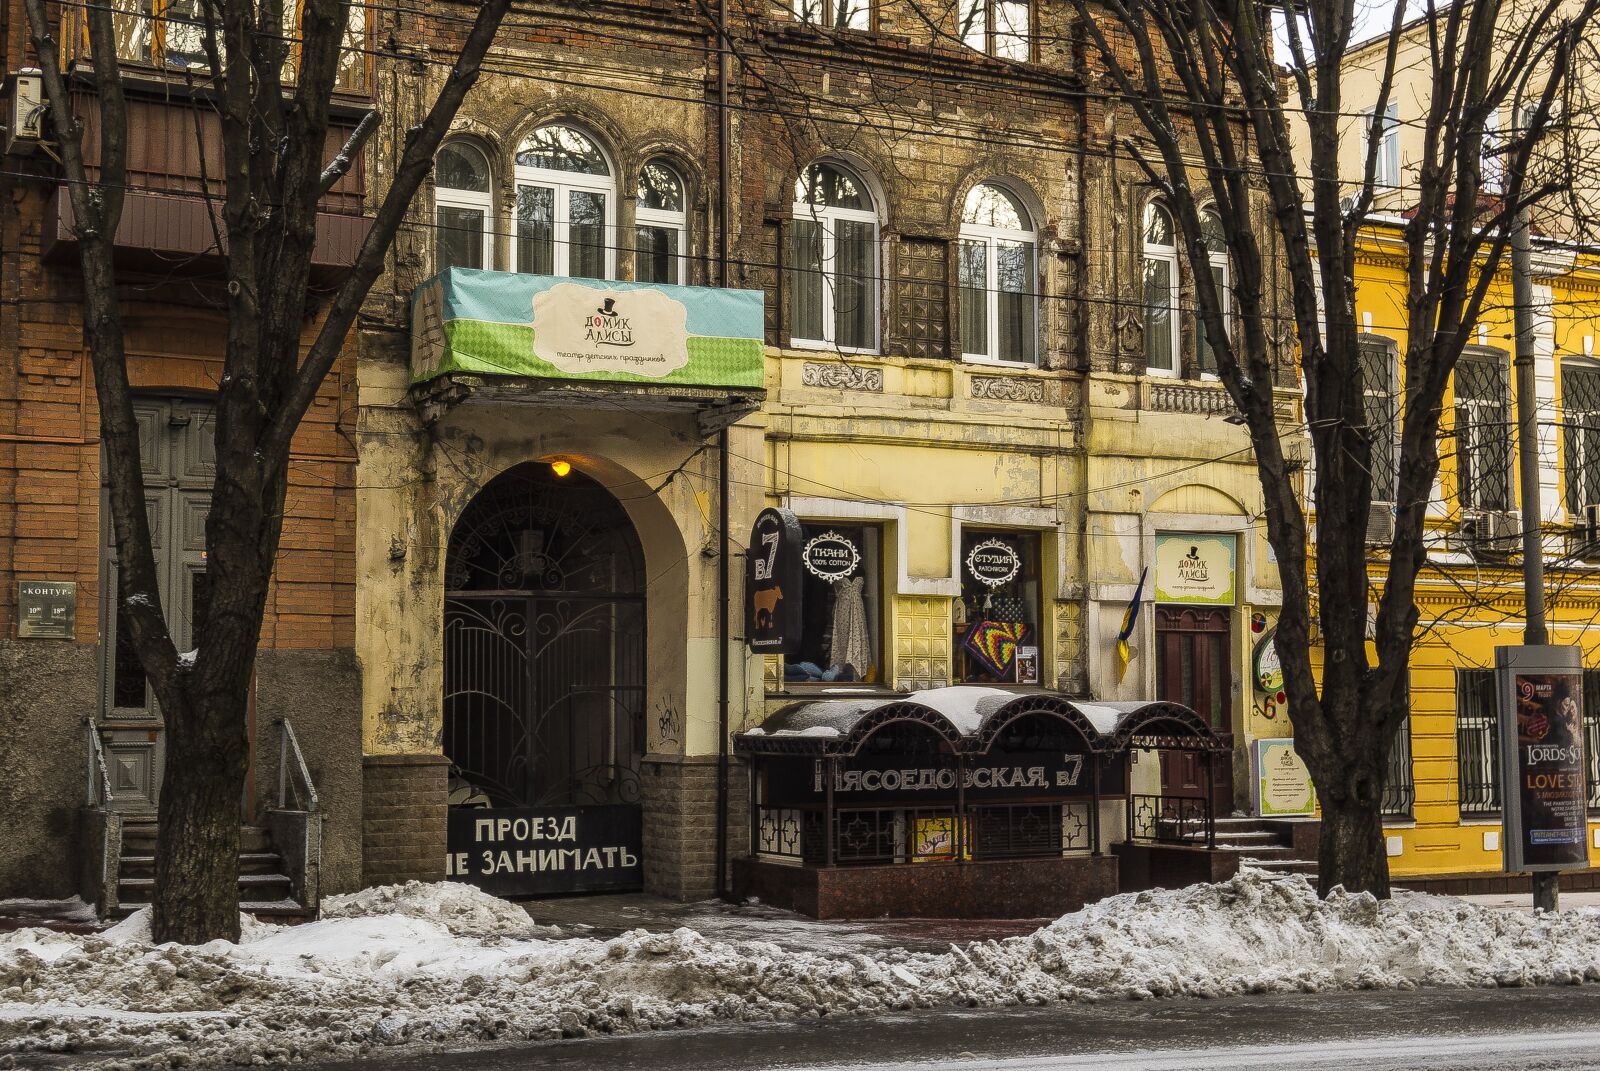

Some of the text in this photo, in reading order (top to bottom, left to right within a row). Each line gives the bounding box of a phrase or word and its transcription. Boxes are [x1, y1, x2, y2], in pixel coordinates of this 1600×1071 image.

[584, 315, 633, 330] ДОМИК
[584, 329, 633, 343] АЛИСЫ
[557, 352, 666, 365] театр детских праздников
[812, 548, 849, 558] ТКАНИ
[974, 554, 1013, 564] СТУДИЯ
[828, 559, 851, 567] COTTON
[978, 565, 1009, 573] PATCHWORK
[1178, 559, 1208, 569] ДОМИК
[1177, 569, 1208, 579] АЛИСЫ
[1522, 682, 1534, 702] 9
[1527, 745, 1566, 765] LORDS
[1527, 774, 1565, 789] LOVE
[475, 816, 576, 843] ПРОЕЗД
[481, 846, 638, 875] ЗАНИМАТЬ
